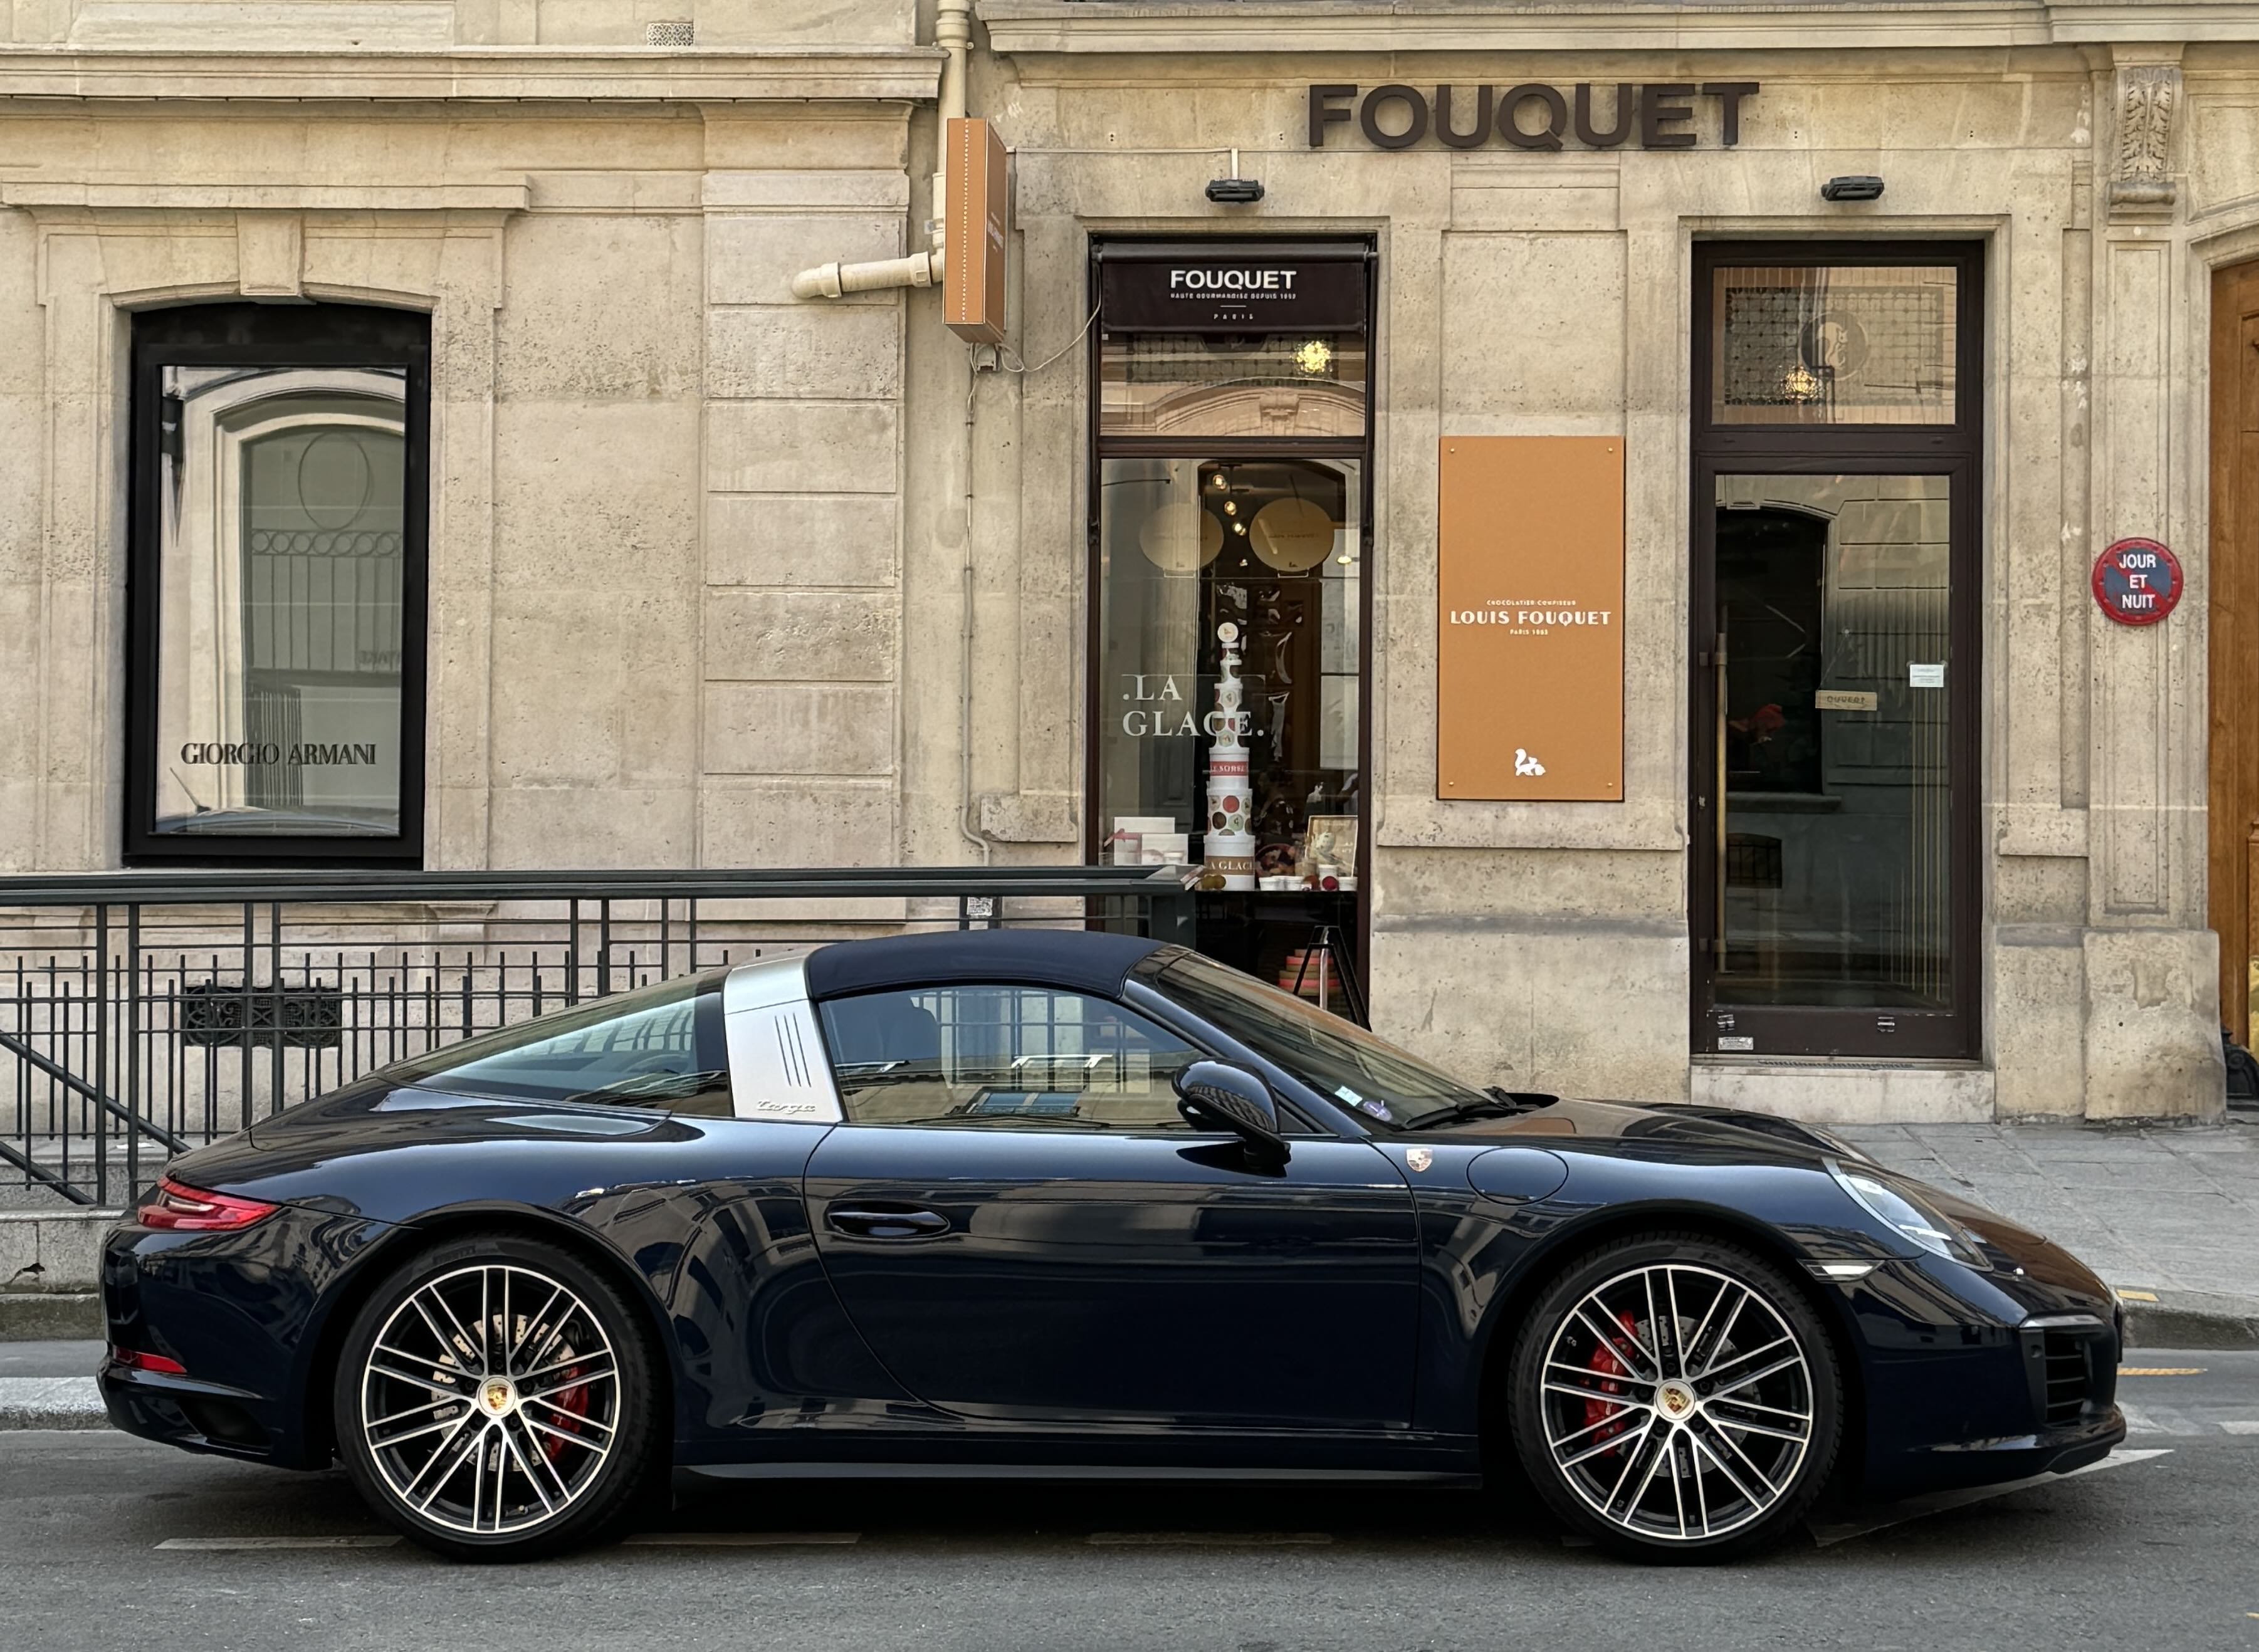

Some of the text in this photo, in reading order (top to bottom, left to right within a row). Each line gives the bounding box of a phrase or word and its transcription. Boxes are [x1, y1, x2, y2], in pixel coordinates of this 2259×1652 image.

[1309, 81, 1760, 152] FOUQUET
[1170, 270, 1297, 290] FOUQUET
[2119, 554, 2156, 568] JOUR
[2129, 574, 2148, 588] ET
[2122, 594, 2156, 609] NUIT
[1450, 610, 1612, 627] LOUIS FOUQUET
[181, 743, 376, 765] GIORGIO ARMANI
